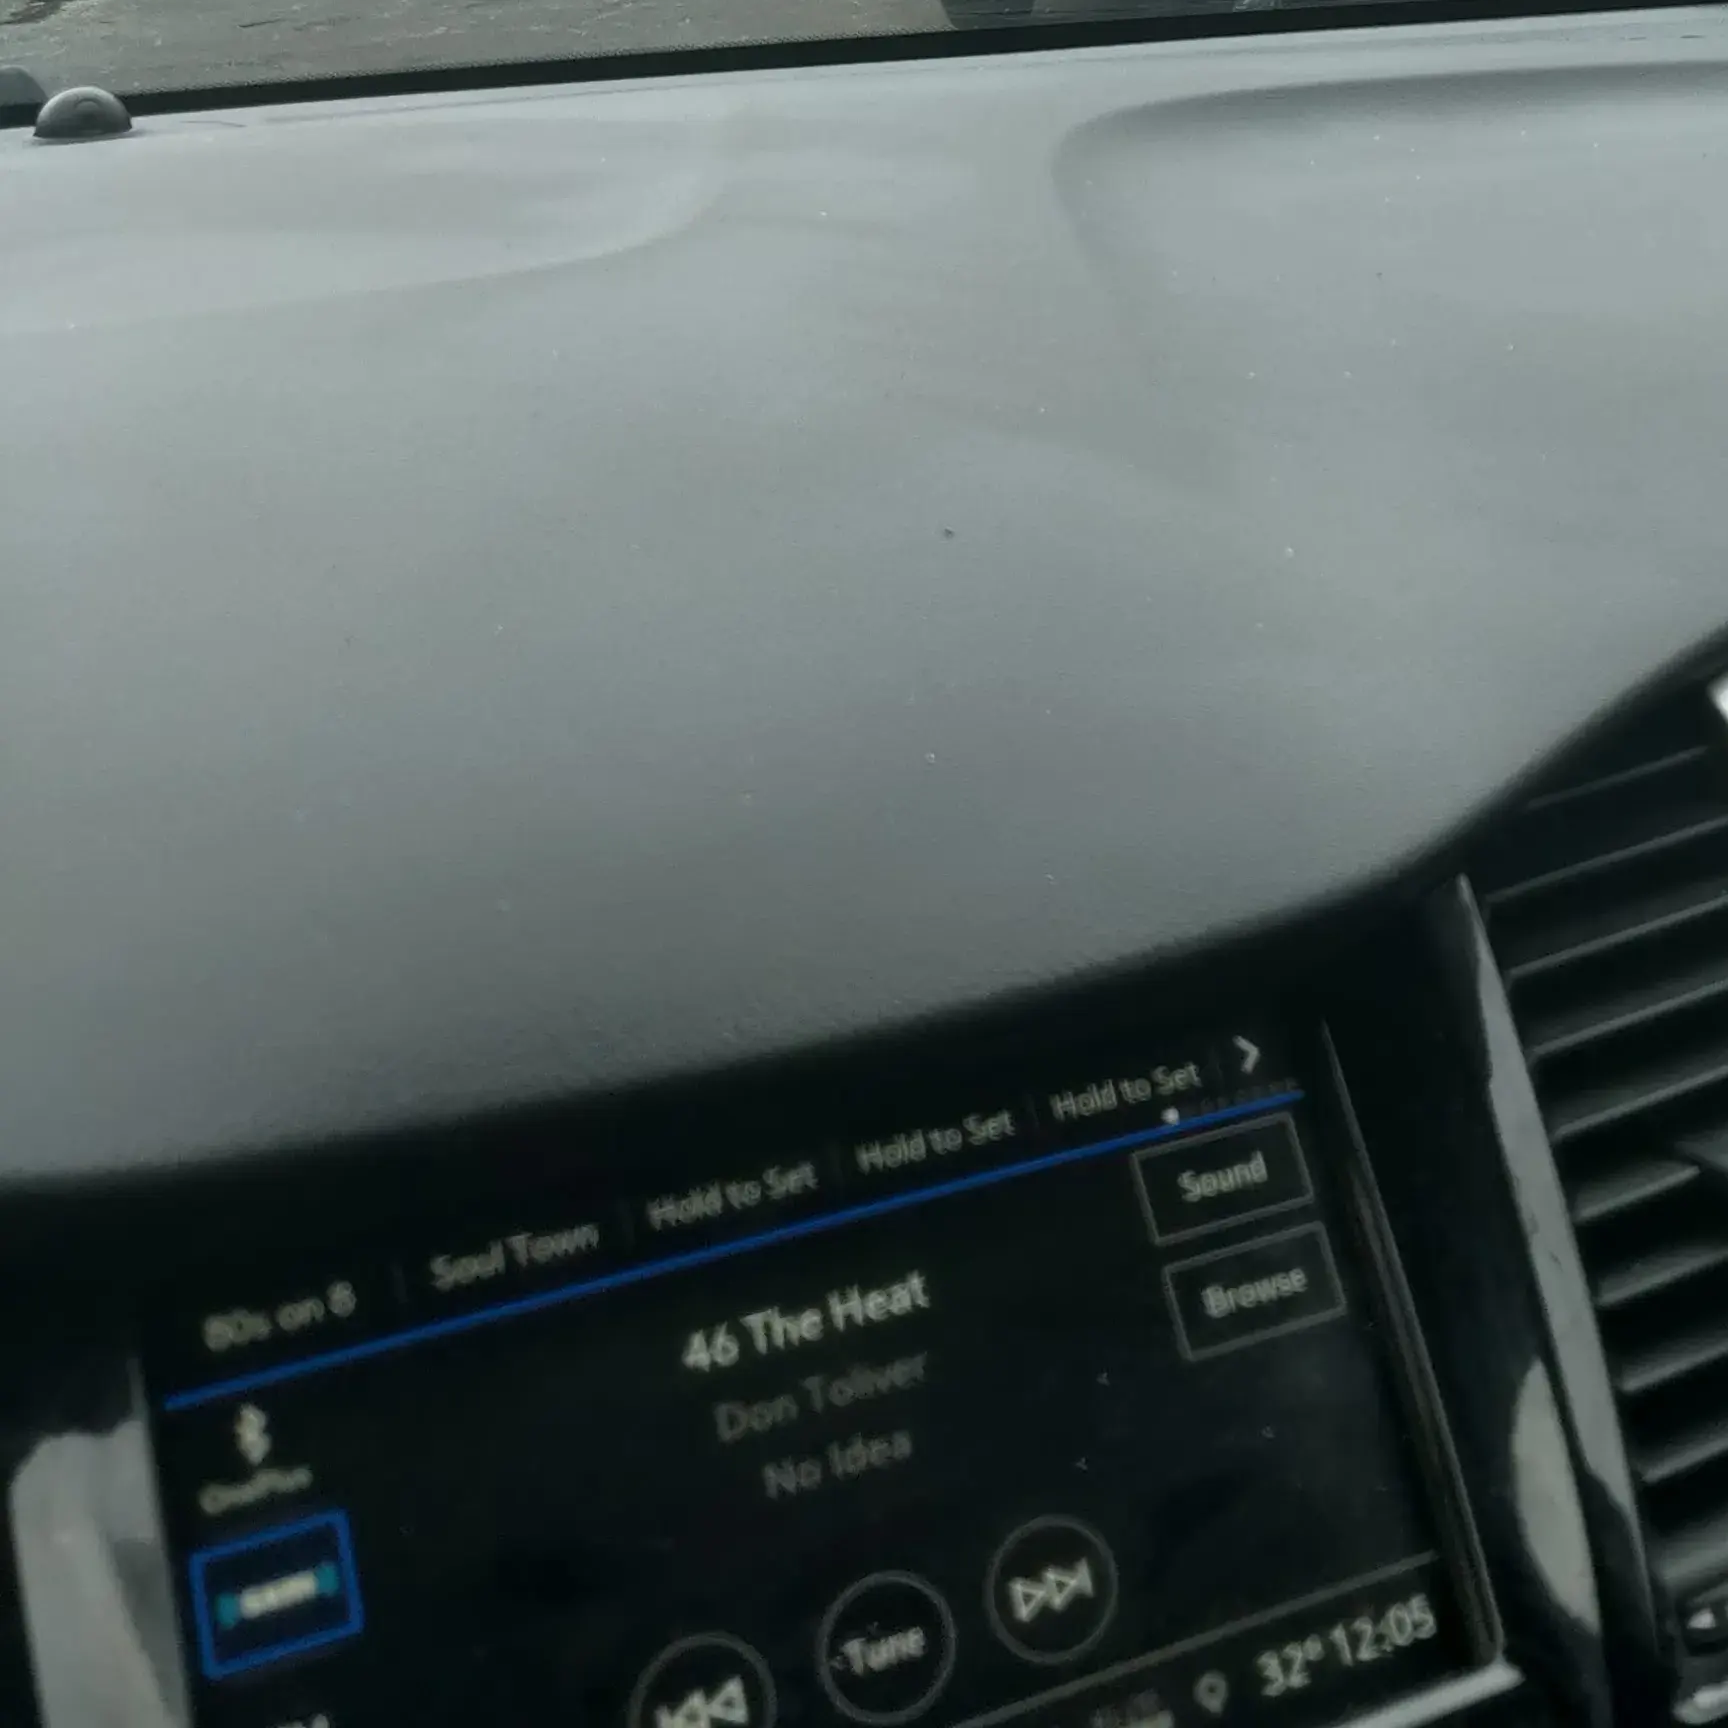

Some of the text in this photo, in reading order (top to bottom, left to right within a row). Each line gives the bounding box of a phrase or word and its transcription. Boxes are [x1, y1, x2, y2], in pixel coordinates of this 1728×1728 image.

[1049, 1060, 1204, 1123] Hold to Set
[855, 1108, 1016, 1174] Hold to Set
[645, 1161, 820, 1232] Hold to Set
[1177, 1152, 1269, 1203] Sound
[429, 1223, 600, 1292] Soul Town
[681, 1269, 931, 1373] 46 The Heat
[1202, 1265, 1310, 1320] Browse
[712, 1393, 799, 1444] Don
[761, 1455, 823, 1502] No
[840, 1626, 927, 1676] Tune
